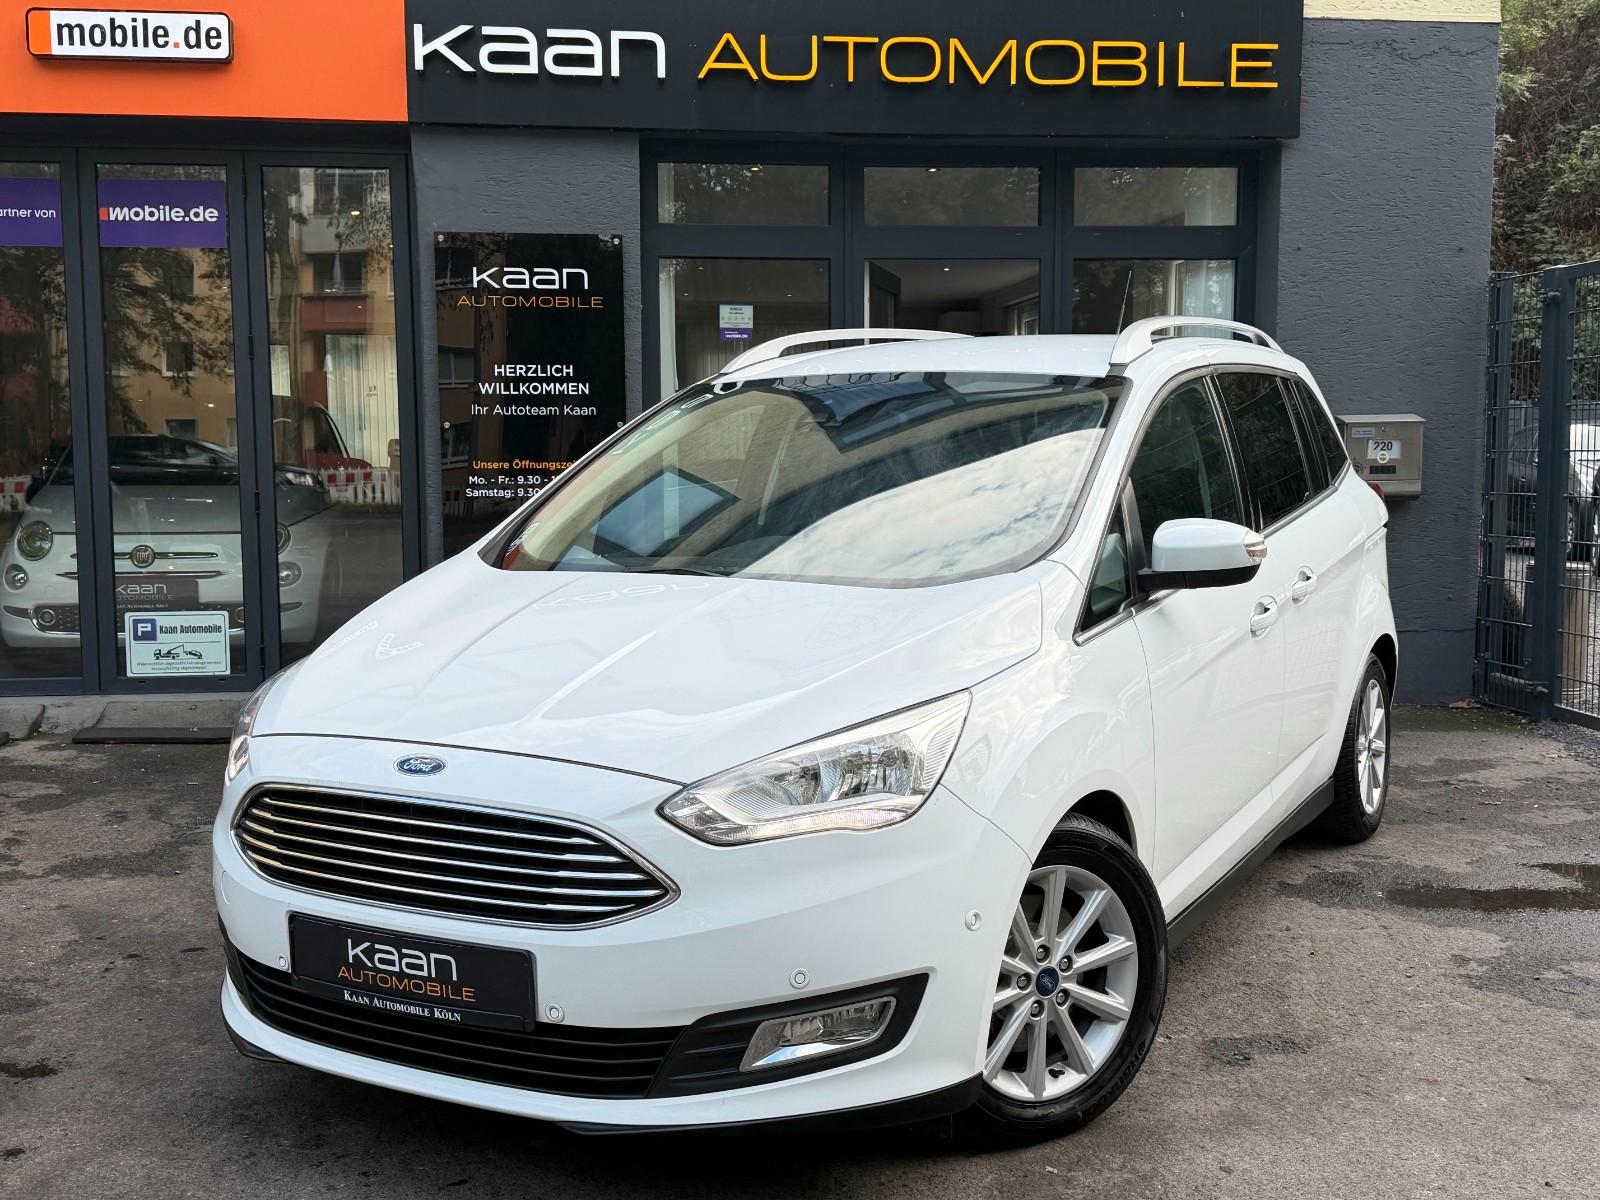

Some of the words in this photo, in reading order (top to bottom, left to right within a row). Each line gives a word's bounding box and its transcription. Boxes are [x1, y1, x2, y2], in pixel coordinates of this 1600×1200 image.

[56, 18, 222, 50] mobile.de
[698, 32, 1279, 88] AUTOMOBILE
[34, 209, 56, 218] von
[109, 205, 219, 222] mobile.de
[457, 295, 604, 308] AUTOMOBILE
[494, 364, 574, 377] HERZLICH
[478, 382, 590, 395] WILLKOMMEN
[471, 404, 488, 415] Ihr
[493, 404, 559, 416] Autoteam
[564, 404, 597, 416] Kaan
[1374, 441, 1393, 451] 220
[472, 460, 510, 469] Unsere
[512, 458, 575, 471] Öffnungsze
[468, 476, 488, 485] Mo.
[517, 476, 541, 485] 9.30
[466, 488, 514, 498] Samstag:
[137, 623, 152, 637] P
[160, 625, 178, 635] Kaan
[180, 624, 222, 634] Automobile
[404, 759, 436, 771] Ford
[338, 966, 476, 1002] AUTOMOBILE
